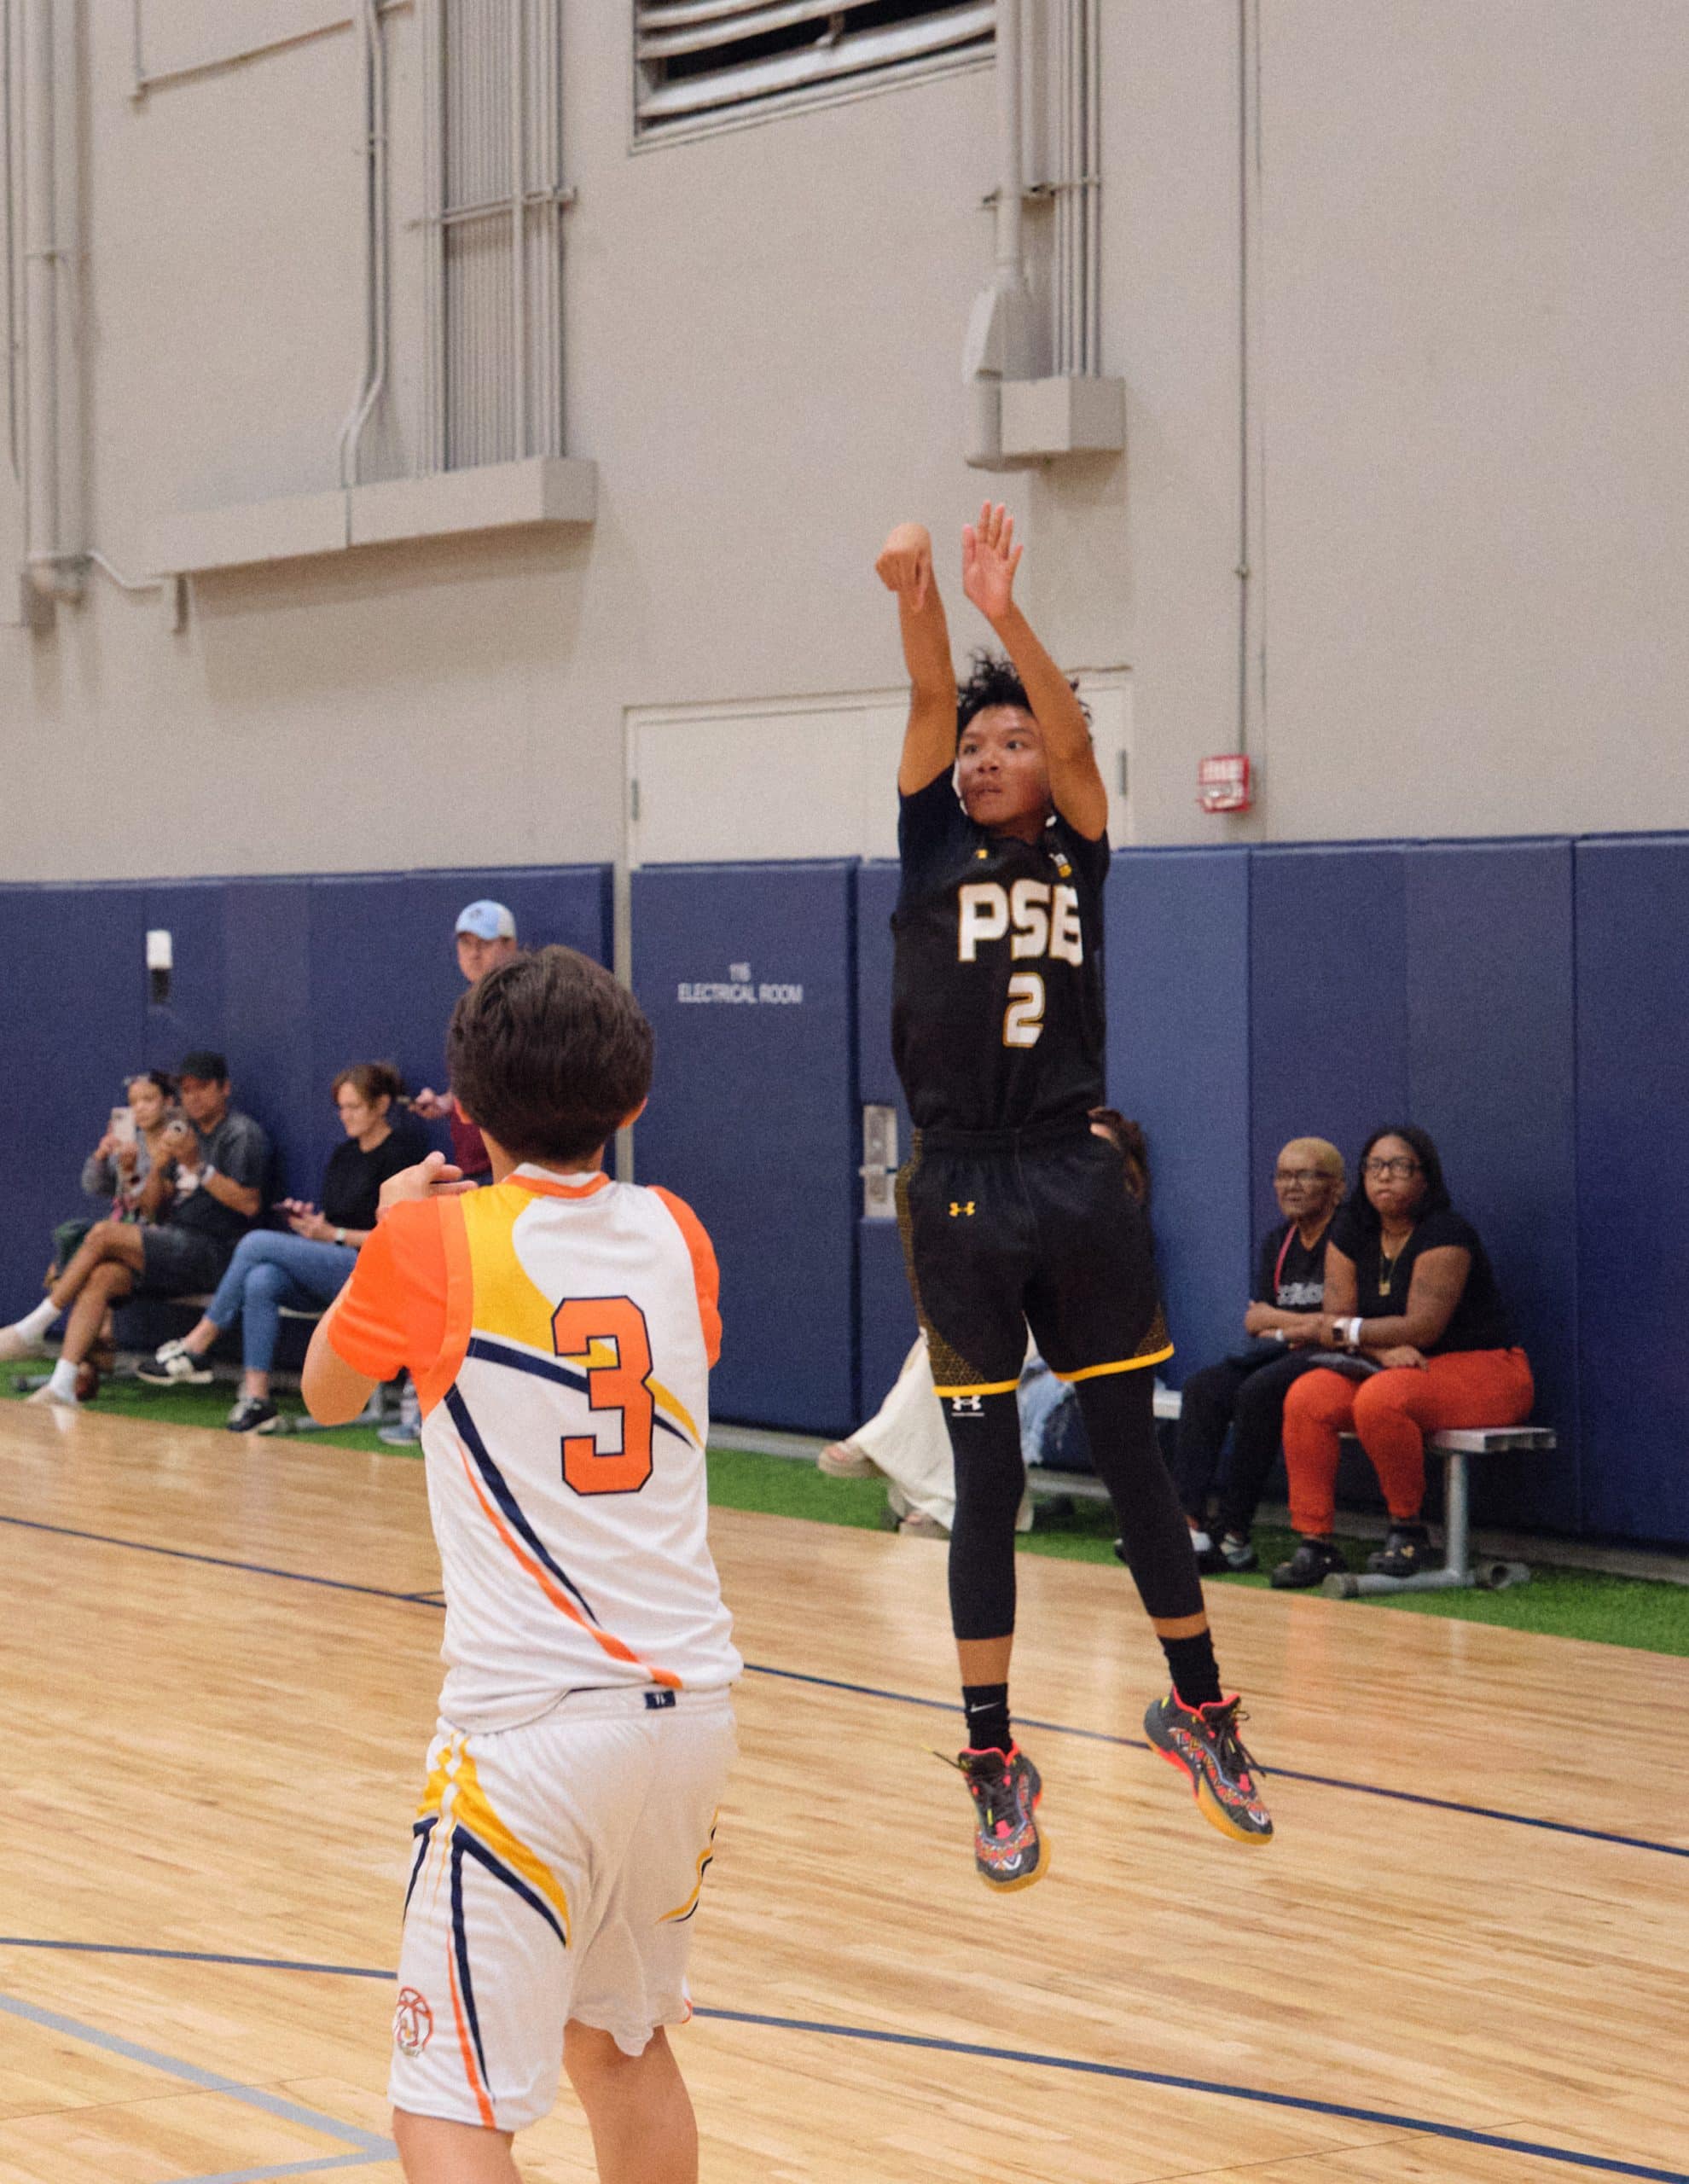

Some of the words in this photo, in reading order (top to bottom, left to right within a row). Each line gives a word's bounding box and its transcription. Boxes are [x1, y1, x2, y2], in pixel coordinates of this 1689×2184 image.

[677, 983, 757, 1004] ELECTRICAL
[758, 983, 804, 1004] ROOM
[1002, 972, 1046, 1048] 2
[550, 1294, 655, 1496] 3
